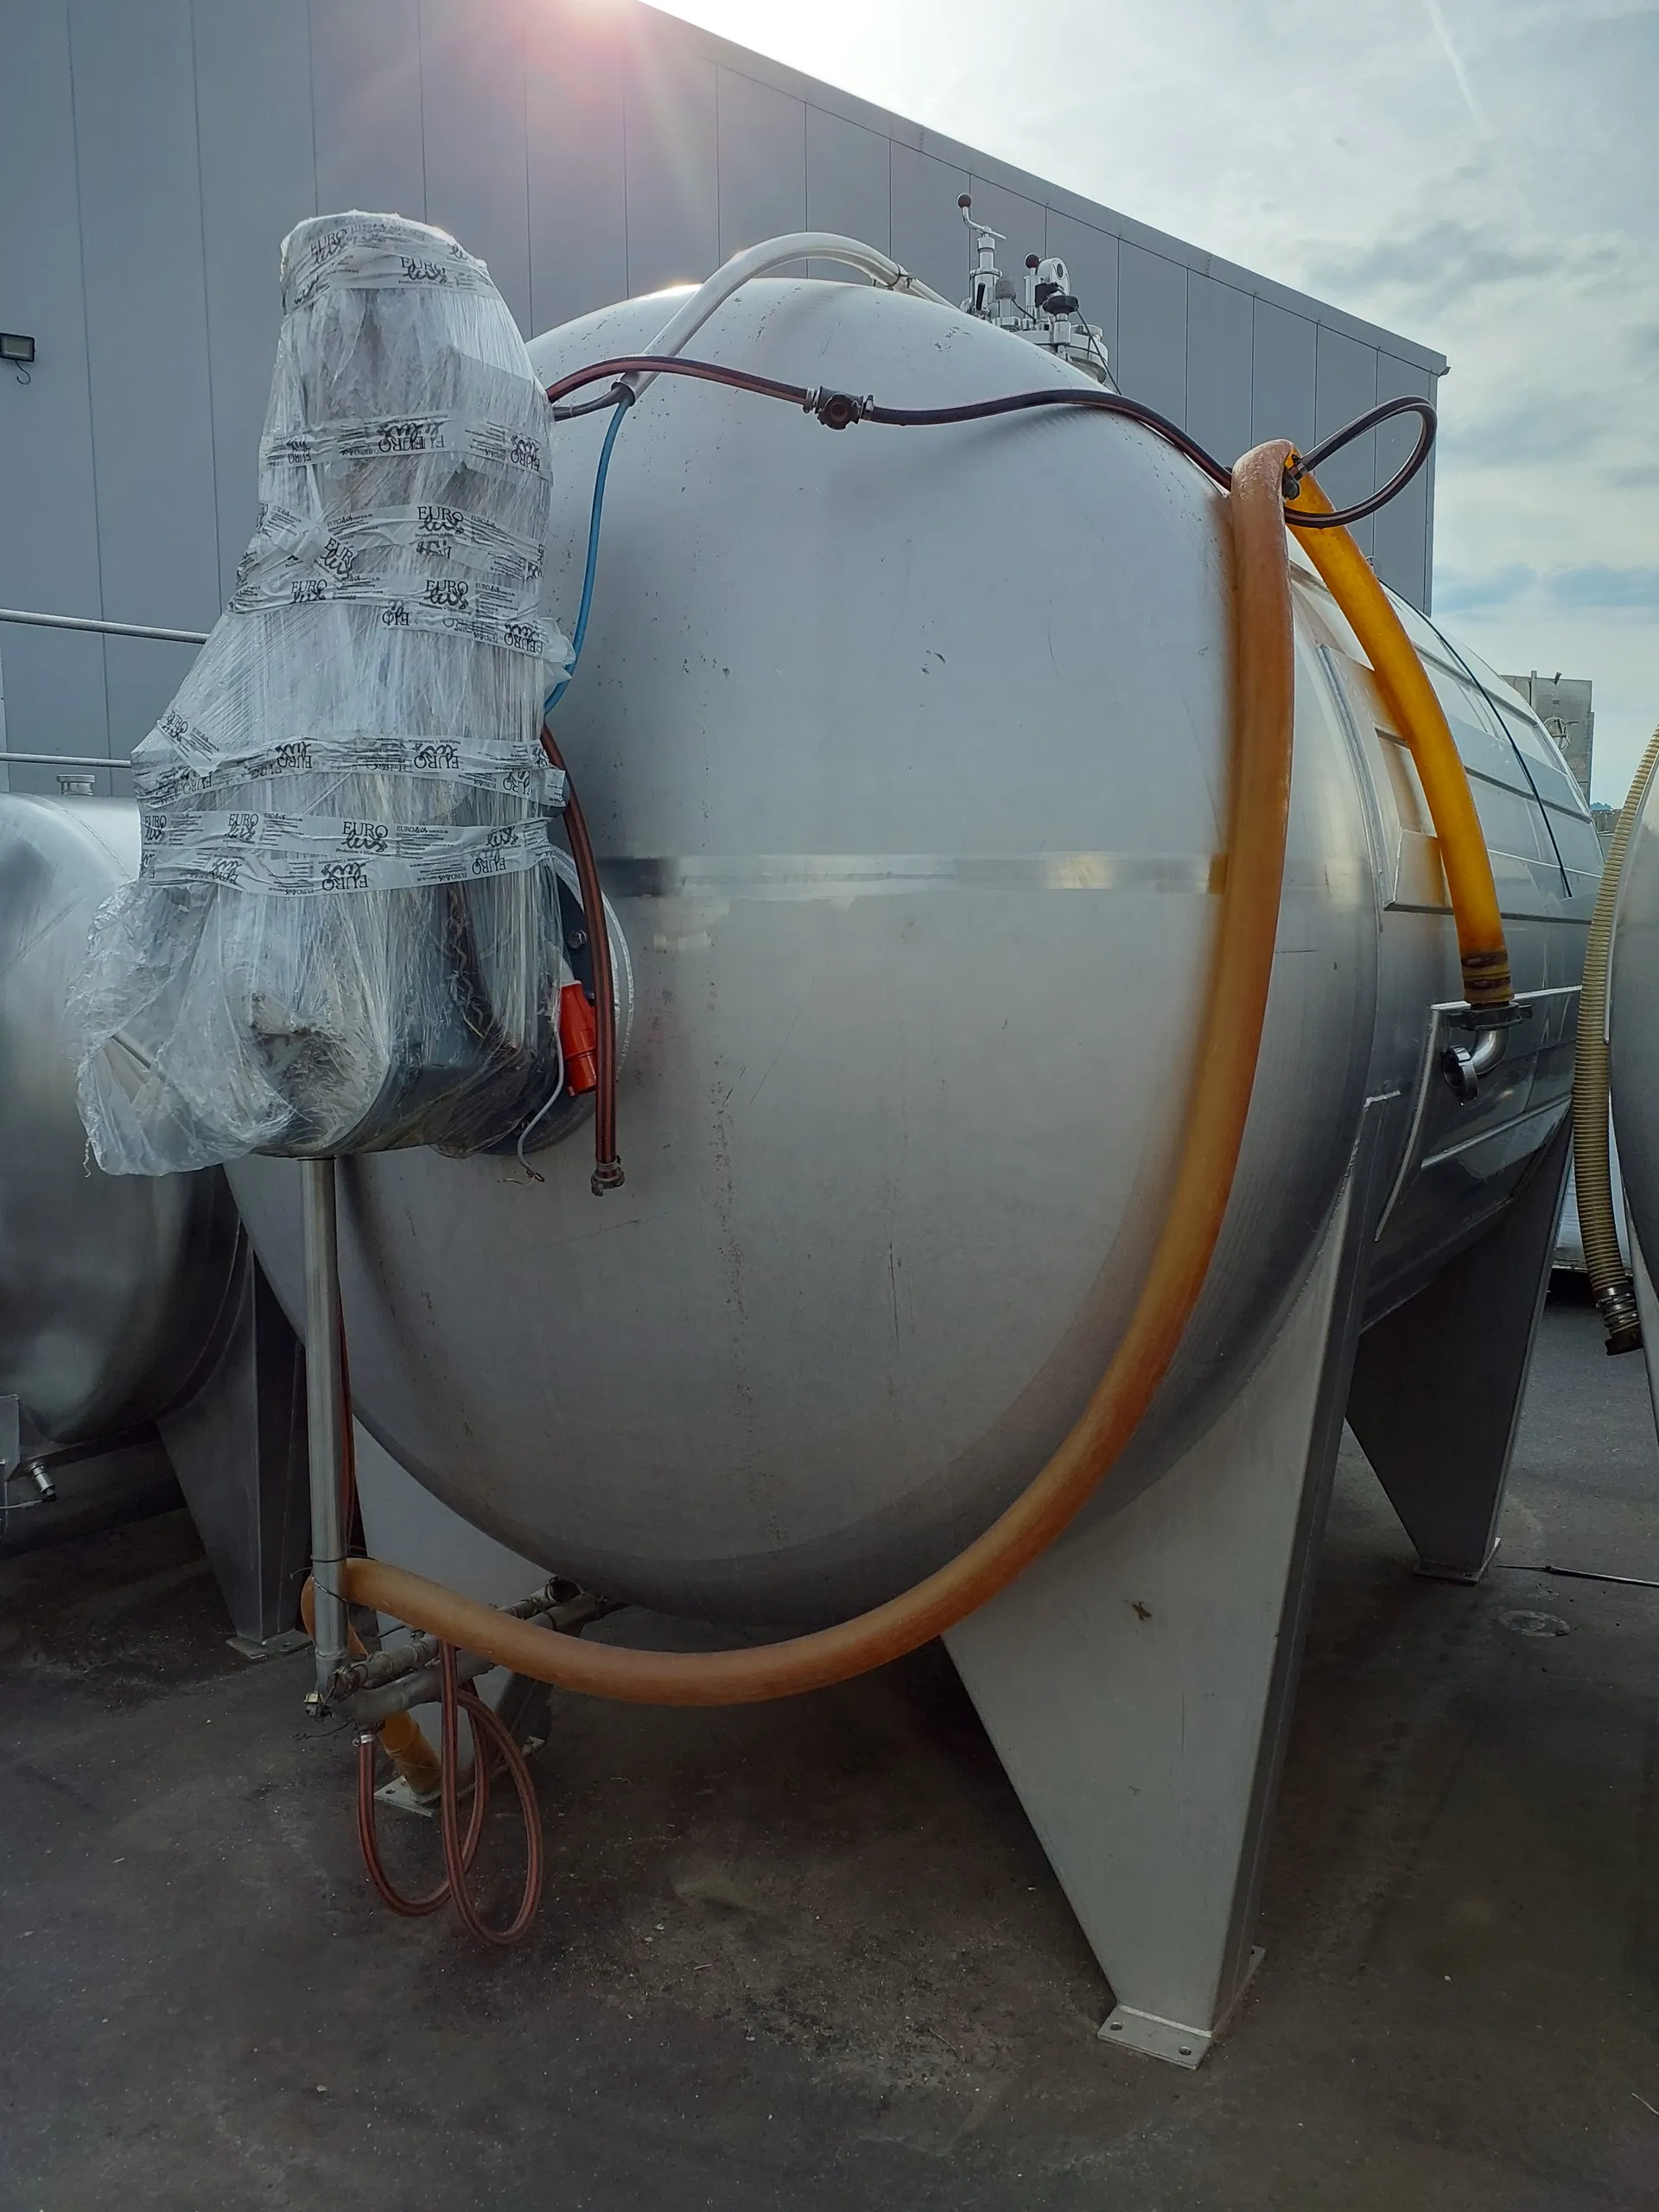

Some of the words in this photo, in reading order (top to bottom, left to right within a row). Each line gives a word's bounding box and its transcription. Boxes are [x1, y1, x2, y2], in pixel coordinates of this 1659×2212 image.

[417, 506, 464, 522] EURO
[291, 579, 327, 594] EURO
[426, 580, 468, 594] EURO
[277, 754, 313, 769] EURO
[414, 753, 460, 770] EURO
[144, 815, 167, 828] EURO
[228, 813, 259, 827] EURO
[342, 821, 389, 839] EURO
[472, 856, 507, 875] EURO
[321, 874, 369, 892] EURO
